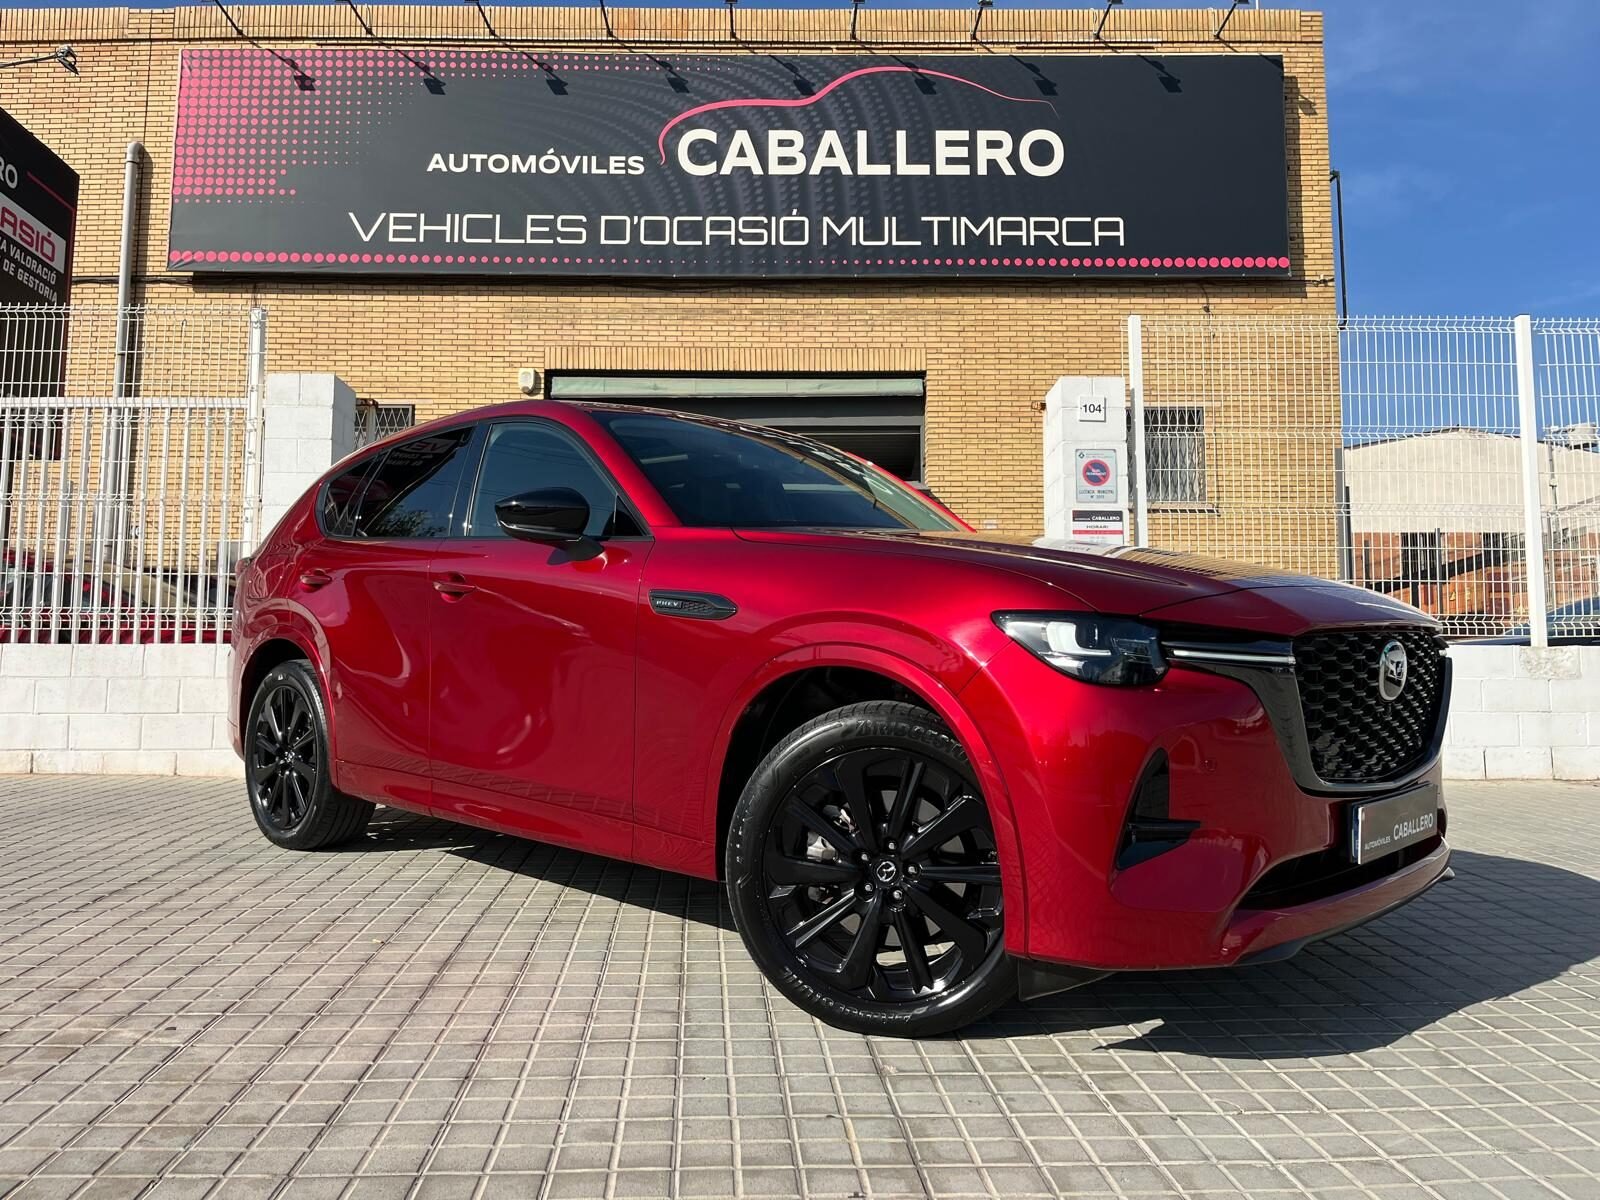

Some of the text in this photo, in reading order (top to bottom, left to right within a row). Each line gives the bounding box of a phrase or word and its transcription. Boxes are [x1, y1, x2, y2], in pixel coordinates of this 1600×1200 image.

[426, 128, 1065, 177] AUTOMÓVILES CABALLERO
[348, 209, 1125, 246] VEHICLES D'OCASIÓ MULTIMARCA
[2, 258, 58, 304] DE GESTORIA
[10, 243, 57, 285] VALORACIÓ
[1082, 404, 1101, 413] 104
[1393, 813, 1433, 841] CABALLERO
